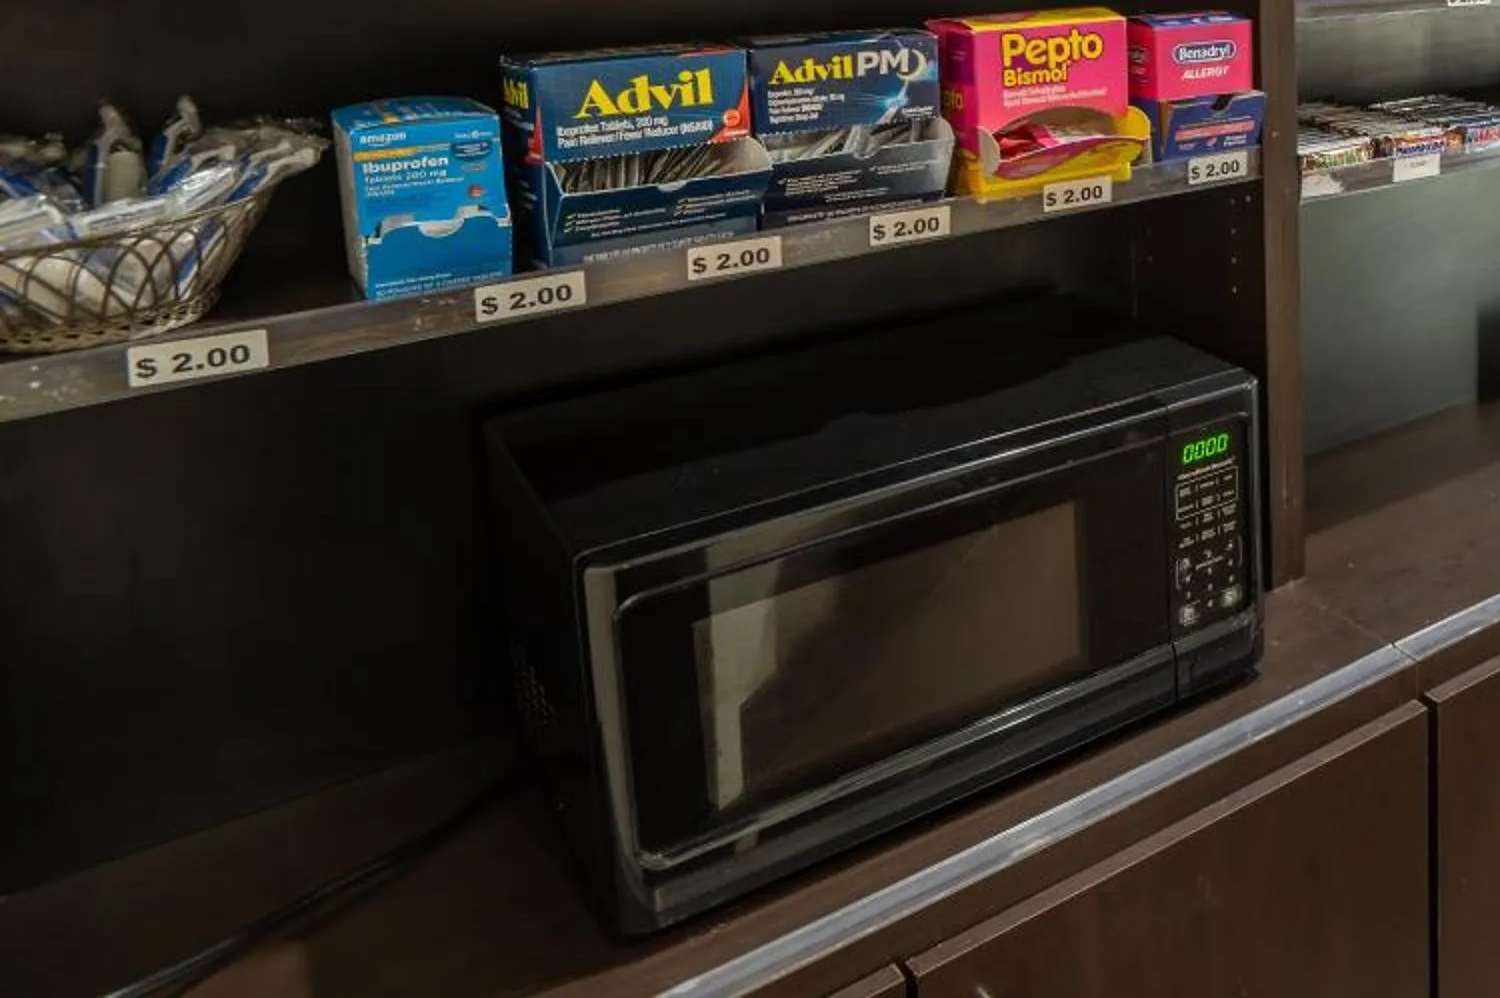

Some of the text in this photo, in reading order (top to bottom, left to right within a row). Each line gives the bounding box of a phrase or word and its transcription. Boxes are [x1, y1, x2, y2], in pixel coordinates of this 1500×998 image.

[1002, 30, 1104, 70] Pepto
[1178, 45, 1232, 61] Benadryl
[769, 48, 909, 85] Advil PM
[1003, 63, 1068, 88] Bismol
[1181, 66, 1230, 80] ALLERGY
[572, 68, 714, 119] Advil
[362, 155, 450, 175] Ibuprofen
[1205, 160, 1240, 177] 2.00
[1064, 185, 1104, 204] 2.00
[893, 217, 940, 237] 2.00
[692, 247, 771, 274] $ 2.00
[481, 295, 498, 315] $
[510, 283, 572, 310] 2.00
[135, 343, 251, 379] $ 2.00
